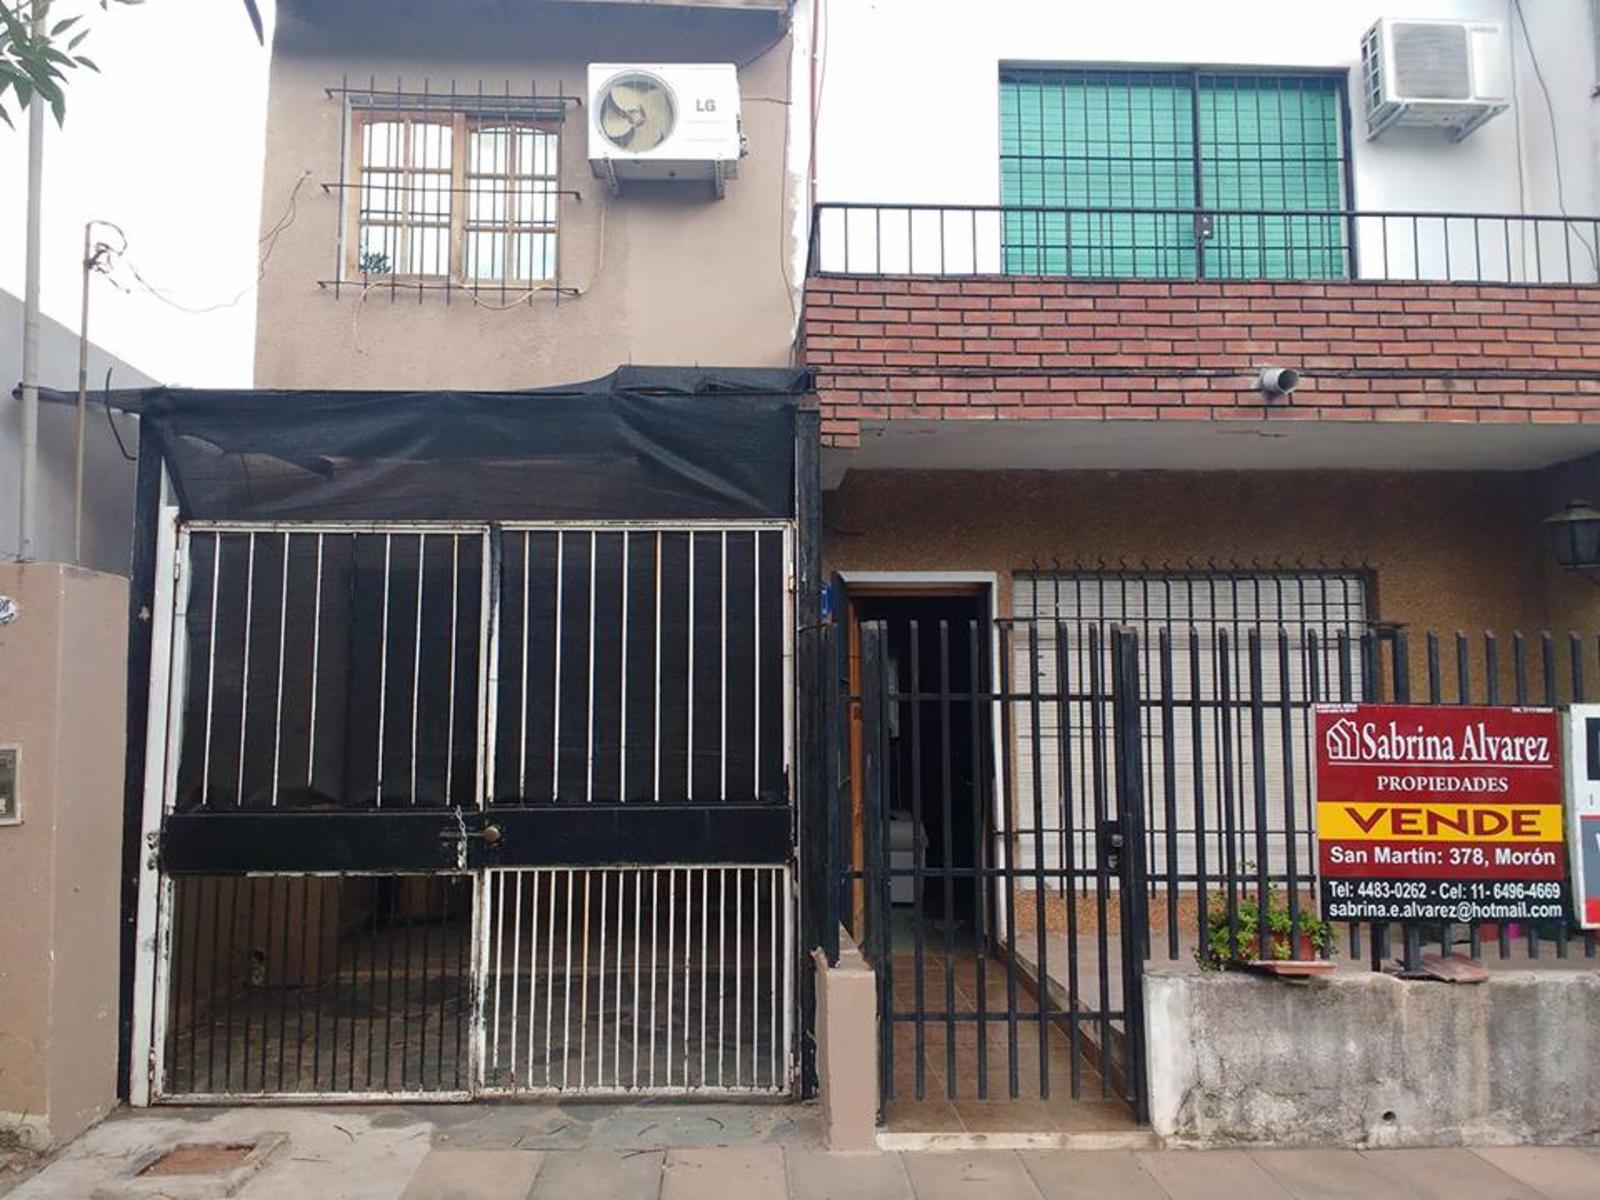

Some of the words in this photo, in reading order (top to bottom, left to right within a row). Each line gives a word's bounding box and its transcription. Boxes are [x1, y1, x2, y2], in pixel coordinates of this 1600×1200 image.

[696, 98, 716, 112] LG
[1362, 721, 1455, 760] Sabrina
[1460, 722, 1550, 761] Alvarez
[1377, 776, 1508, 792] PROPIEDADES
[1344, 808, 1541, 836] VENDE
[1330, 846, 1367, 863] San
[1449, 848, 1489, 868] 378,
[1495, 847, 1555, 866] Morón
[1329, 881, 1354, 898] Tel:
[1358, 881, 1427, 899] 4483-0262
[1439, 882, 1467, 899] Cel:
[1329, 900, 1562, 922] sabrina.e.alvarez@hotmail.com
